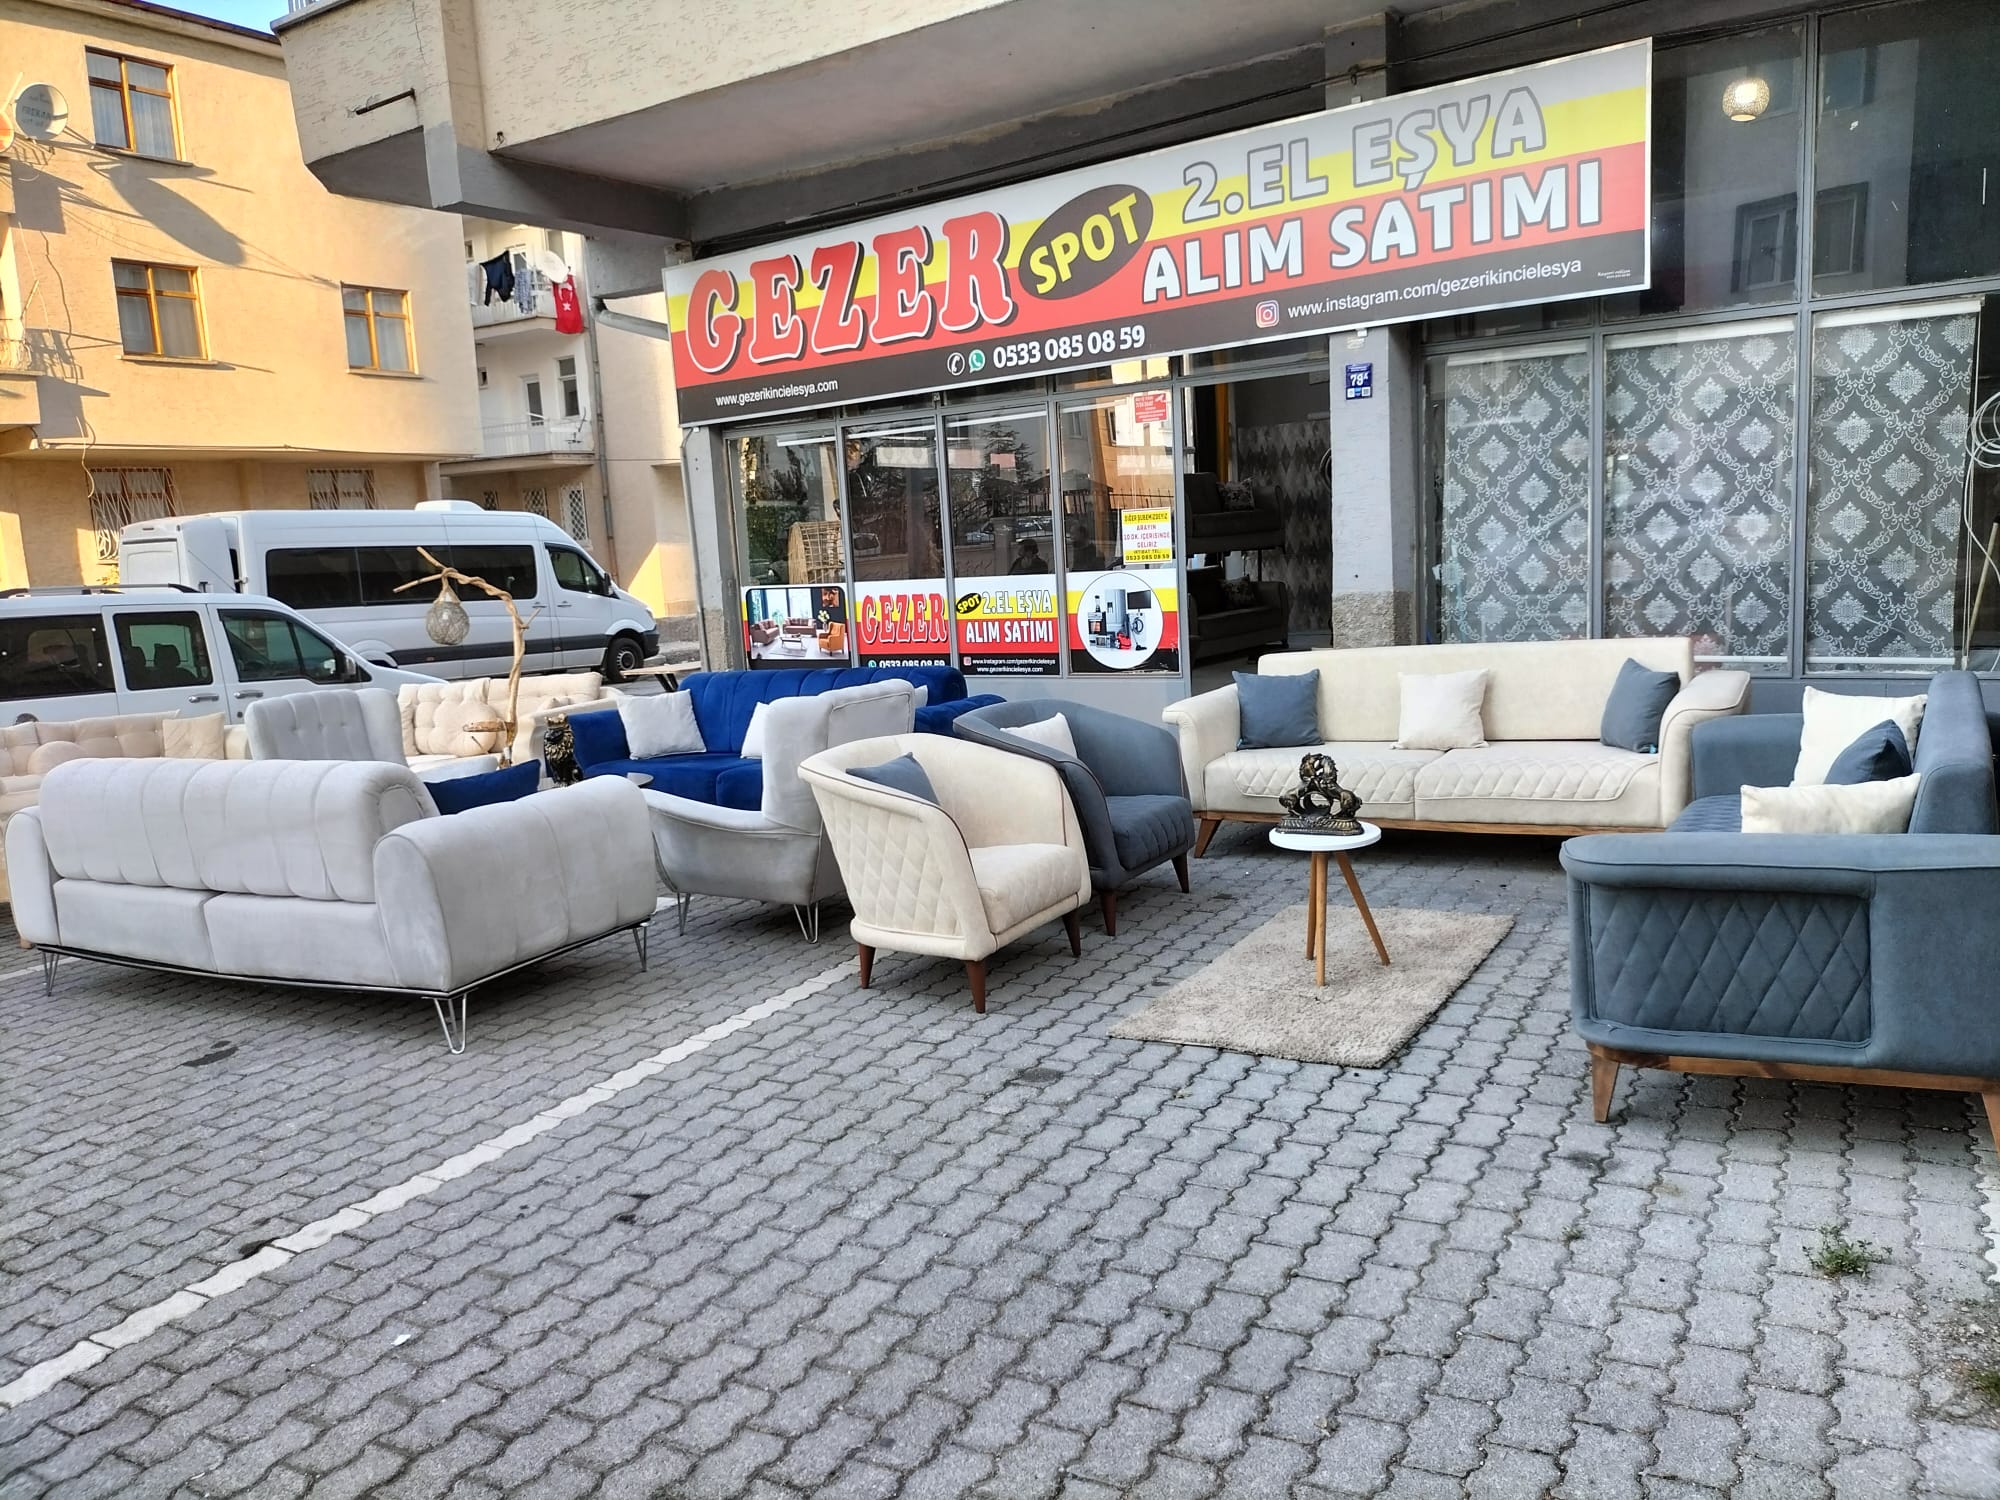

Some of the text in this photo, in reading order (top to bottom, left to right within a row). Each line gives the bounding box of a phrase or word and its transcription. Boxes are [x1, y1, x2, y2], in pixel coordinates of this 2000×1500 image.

[1182, 85, 1547, 224] 2.EL EŞYA
[1029, 193, 1140, 295] SPOT
[1141, 158, 1603, 304] ALIM SATIMI
[686, 211, 1016, 373] GEZER
[1287, 257, 1582, 319] www.instagram.com/gezerikincielesya
[993, 324, 1146, 368] 0533 085 08 59
[715, 379, 839, 406] www.gezerikincielesya.com
[861, 592, 948, 644] GEZER
[957, 594, 980, 613] SPOT
[982, 589, 1052, 618] 2.EL EŞYA
[966, 620, 1053, 643] ALIM SATIMI
